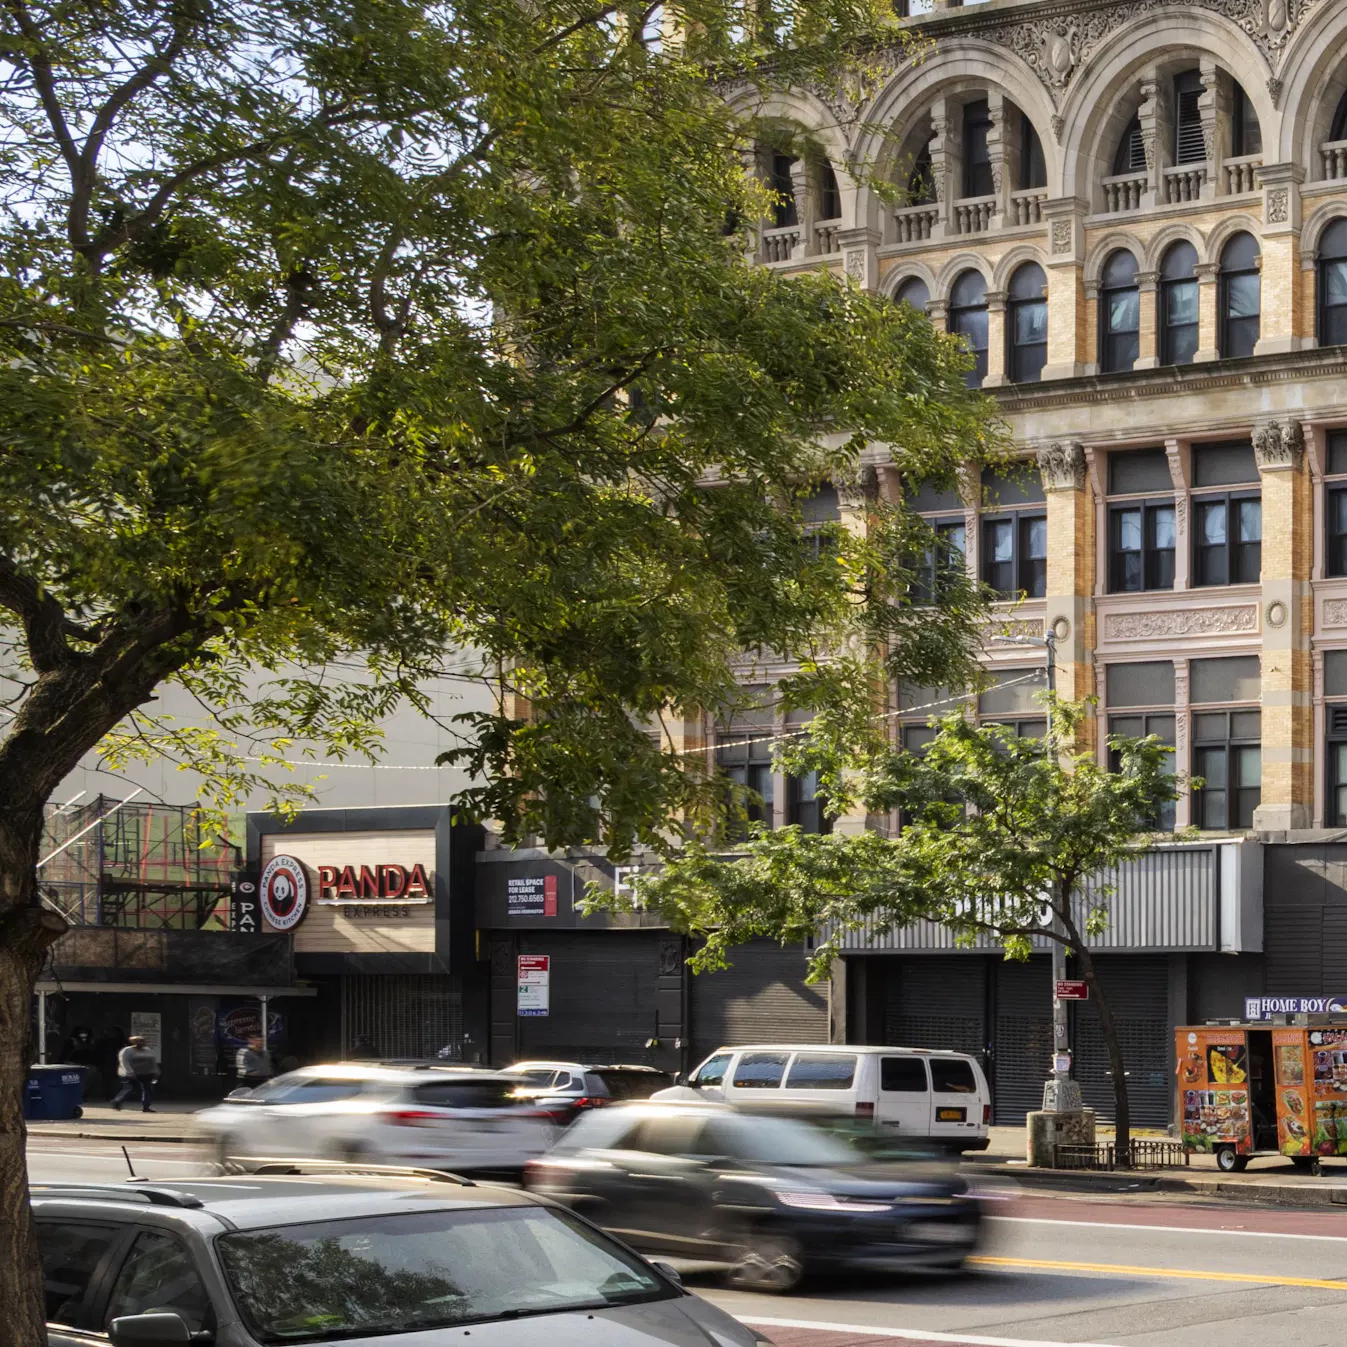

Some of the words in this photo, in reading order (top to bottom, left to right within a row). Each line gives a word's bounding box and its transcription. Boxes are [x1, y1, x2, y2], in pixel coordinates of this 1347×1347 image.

[262, 860, 280, 889] PANDA
[280, 858, 304, 890] EXPRESS
[317, 863, 429, 899] PANDA
[508, 879, 525, 887] RETAIL
[525, 878, 544, 886] SPACE
[508, 886, 519, 894] FOR
[263, 901, 281, 925] CHINESE
[282, 902, 302, 925] KITCHEN
[343, 906, 410, 918] EXPRESS
[1262, 999, 1298, 1012] HOME
[1300, 999, 1327, 1012] BOY
